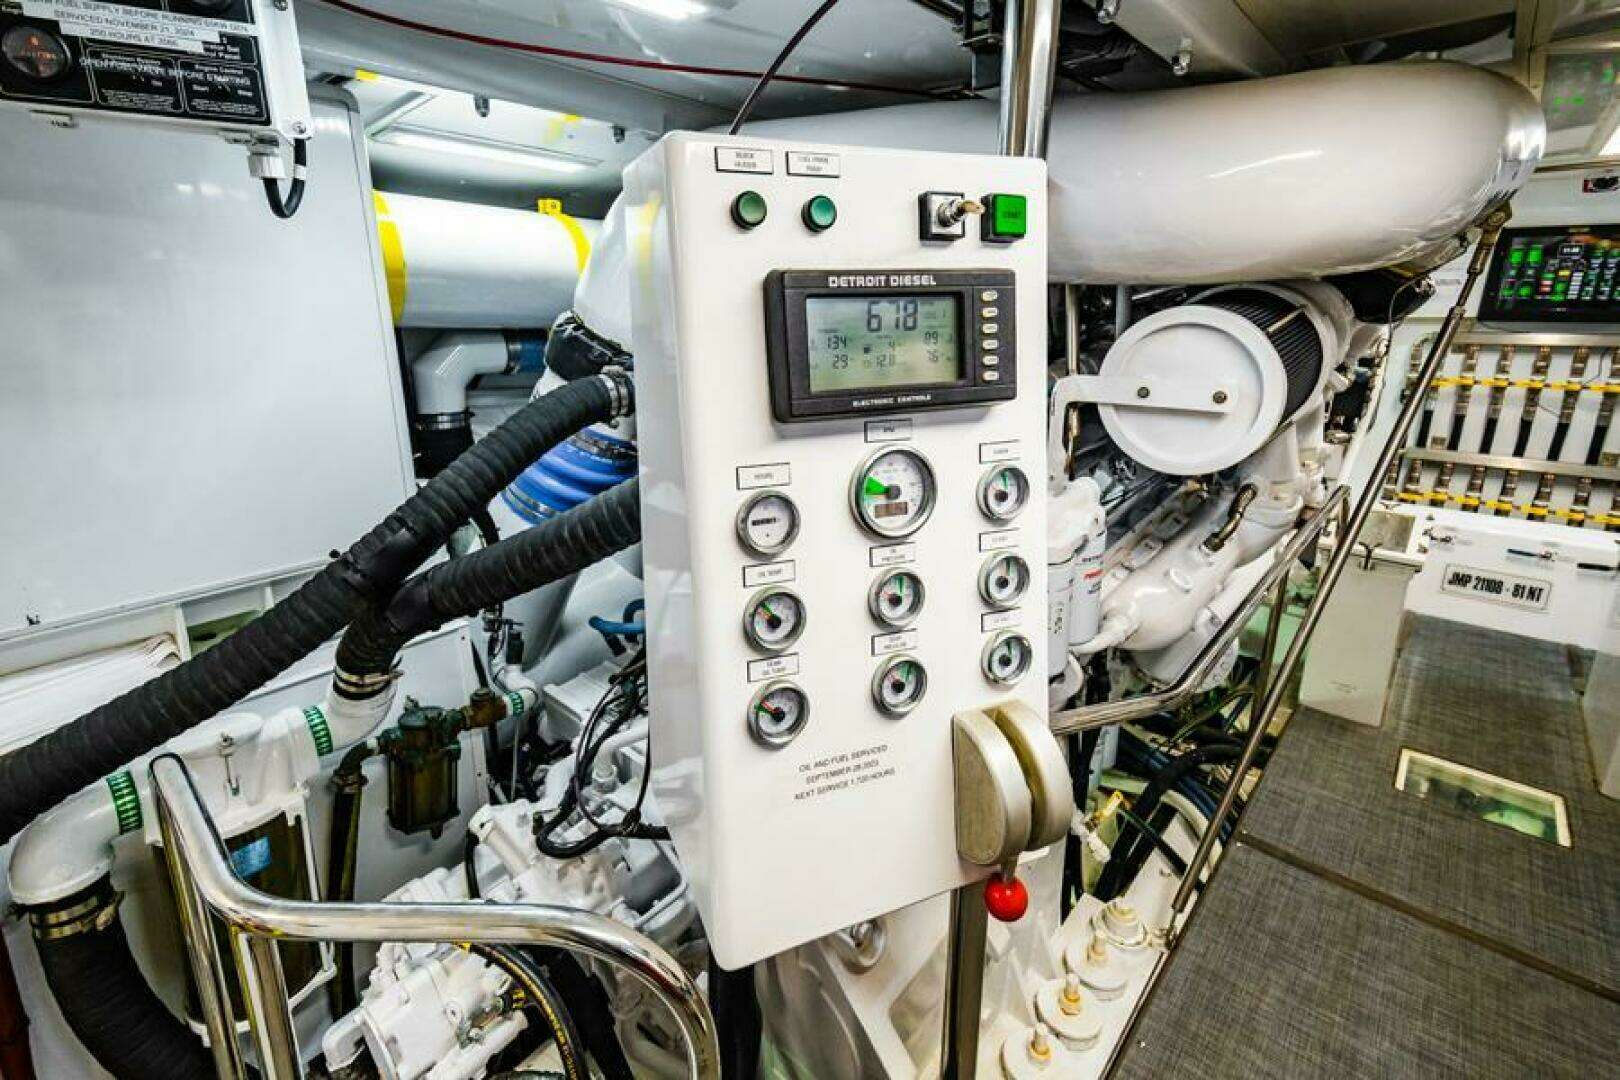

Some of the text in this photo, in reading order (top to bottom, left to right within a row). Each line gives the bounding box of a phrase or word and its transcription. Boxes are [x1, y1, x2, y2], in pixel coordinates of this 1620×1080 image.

[828, 275, 937, 287] DETROIT DIESEL
[867, 300, 919, 331] 678
[813, 758, 830, 768] AND
[831, 753, 849, 764] FUEL
[851, 744, 888, 759] SERVICED
